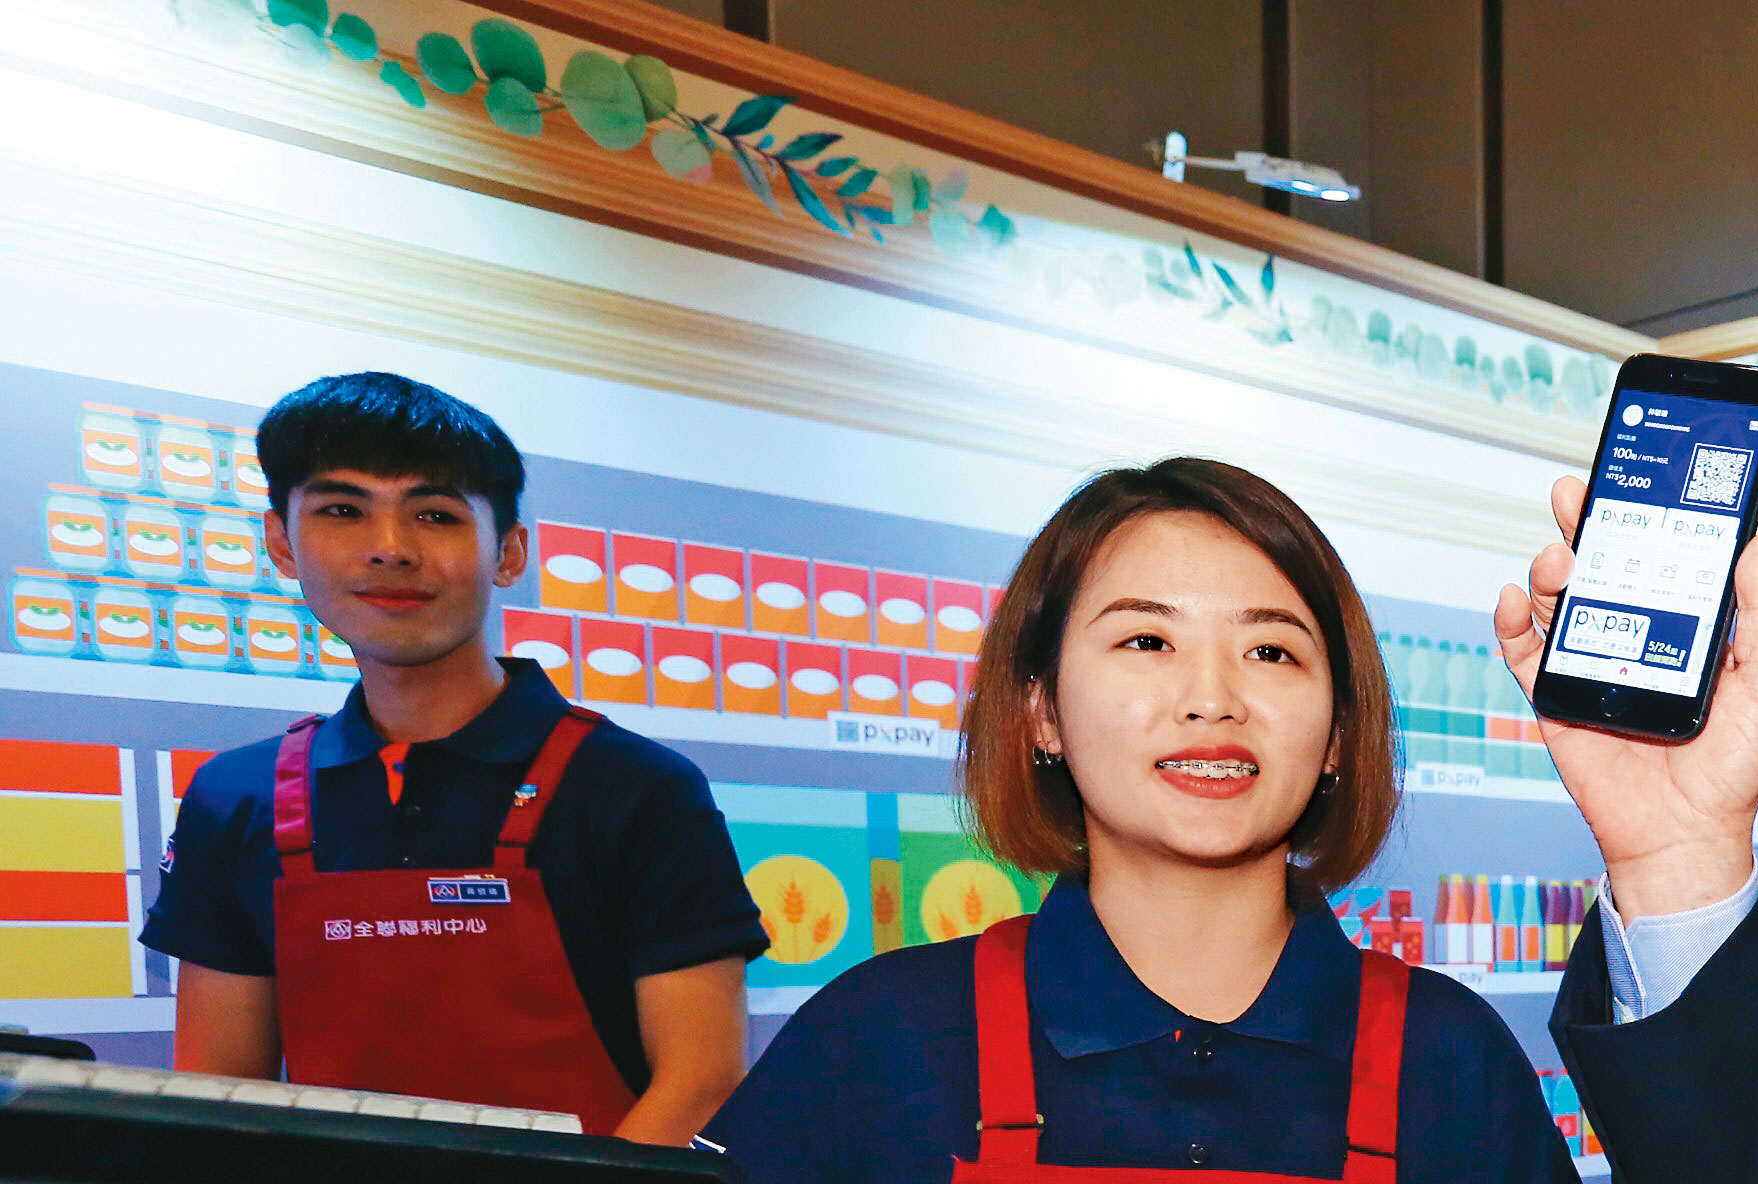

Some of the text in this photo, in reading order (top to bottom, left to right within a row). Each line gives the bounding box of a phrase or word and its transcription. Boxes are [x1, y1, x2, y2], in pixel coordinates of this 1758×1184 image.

[1601, 509, 1651, 529] pxpay
[1674, 520, 1725, 540] pxpay
[1574, 610, 1645, 638] pxpay
[864, 724, 934, 748] pxpay
